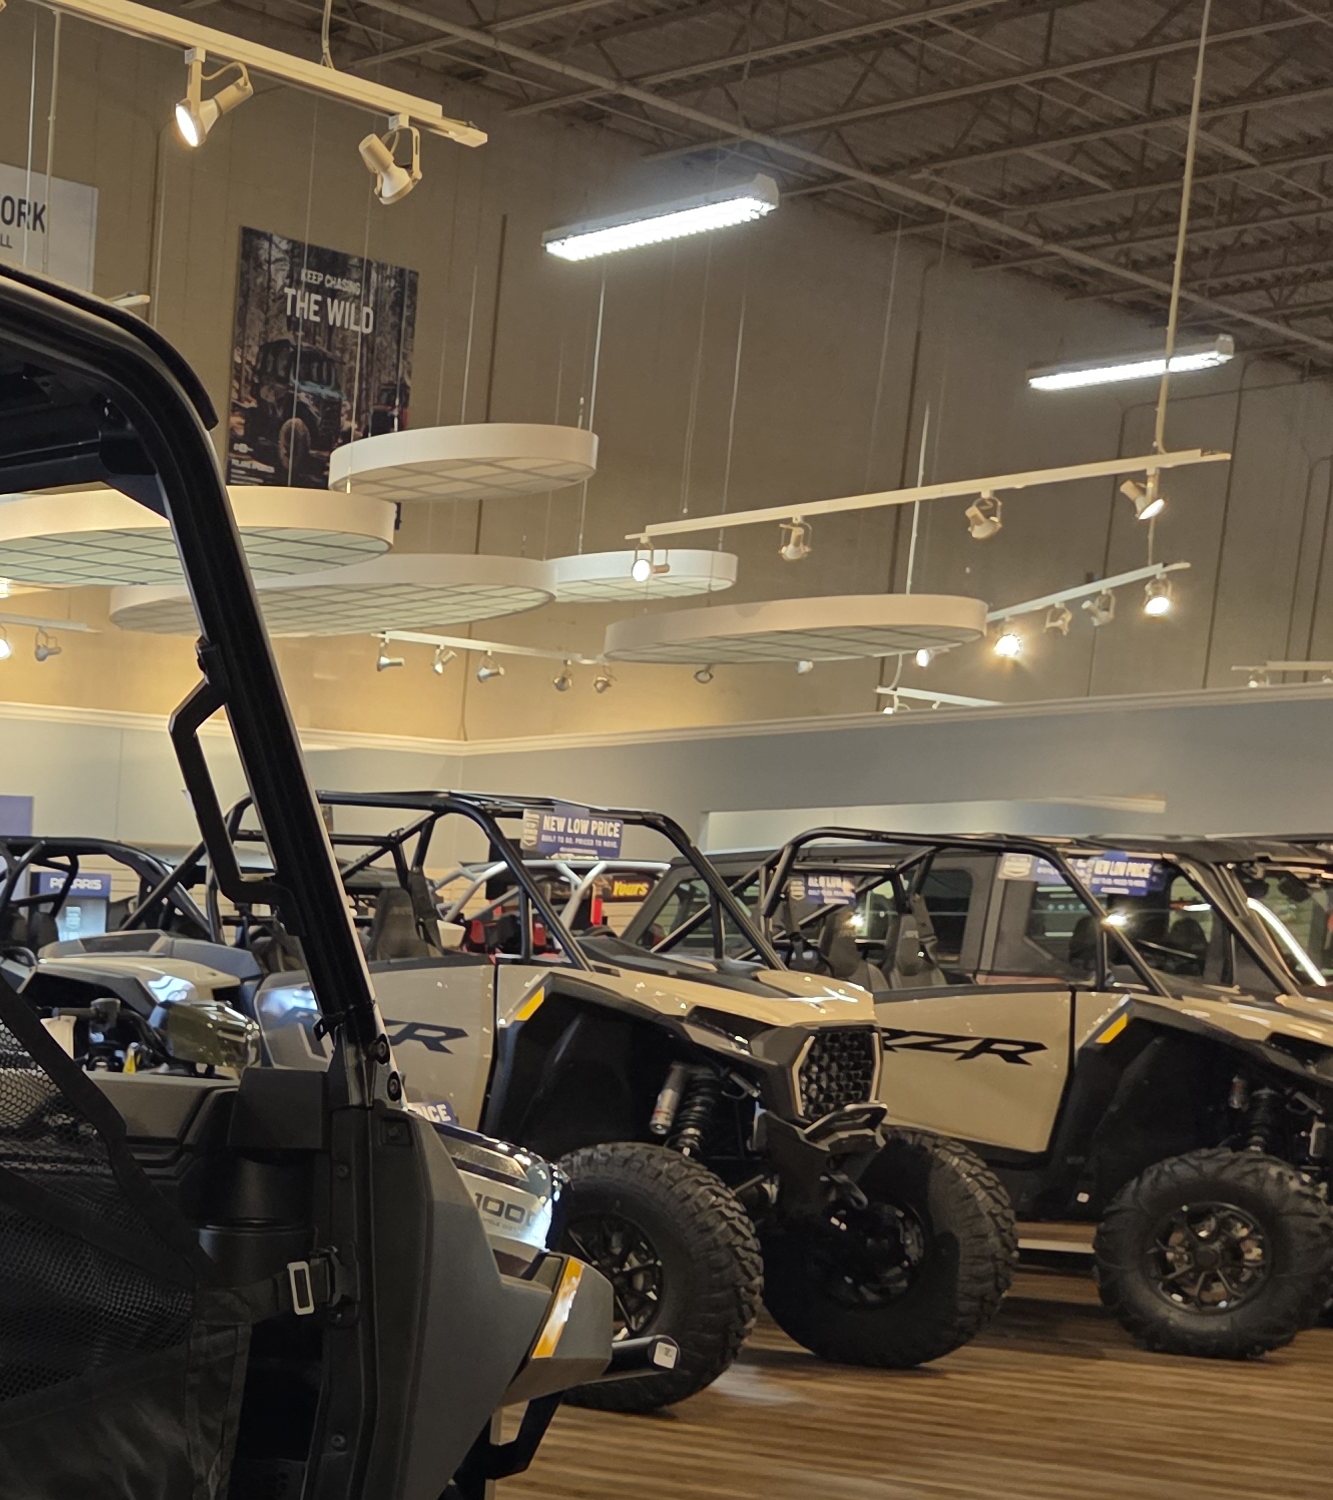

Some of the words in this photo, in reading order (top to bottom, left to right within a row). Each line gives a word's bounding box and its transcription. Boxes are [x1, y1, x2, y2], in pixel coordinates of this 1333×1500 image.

[283, 287, 322, 323] THE
[327, 297, 373, 334] WILD
[543, 815, 566, 832] NEW
[567, 818, 590, 835] LOW
[591, 820, 621, 838] PRICE
[613, 880, 650, 897] Yours
[419, 1103, 452, 1122] ICE
